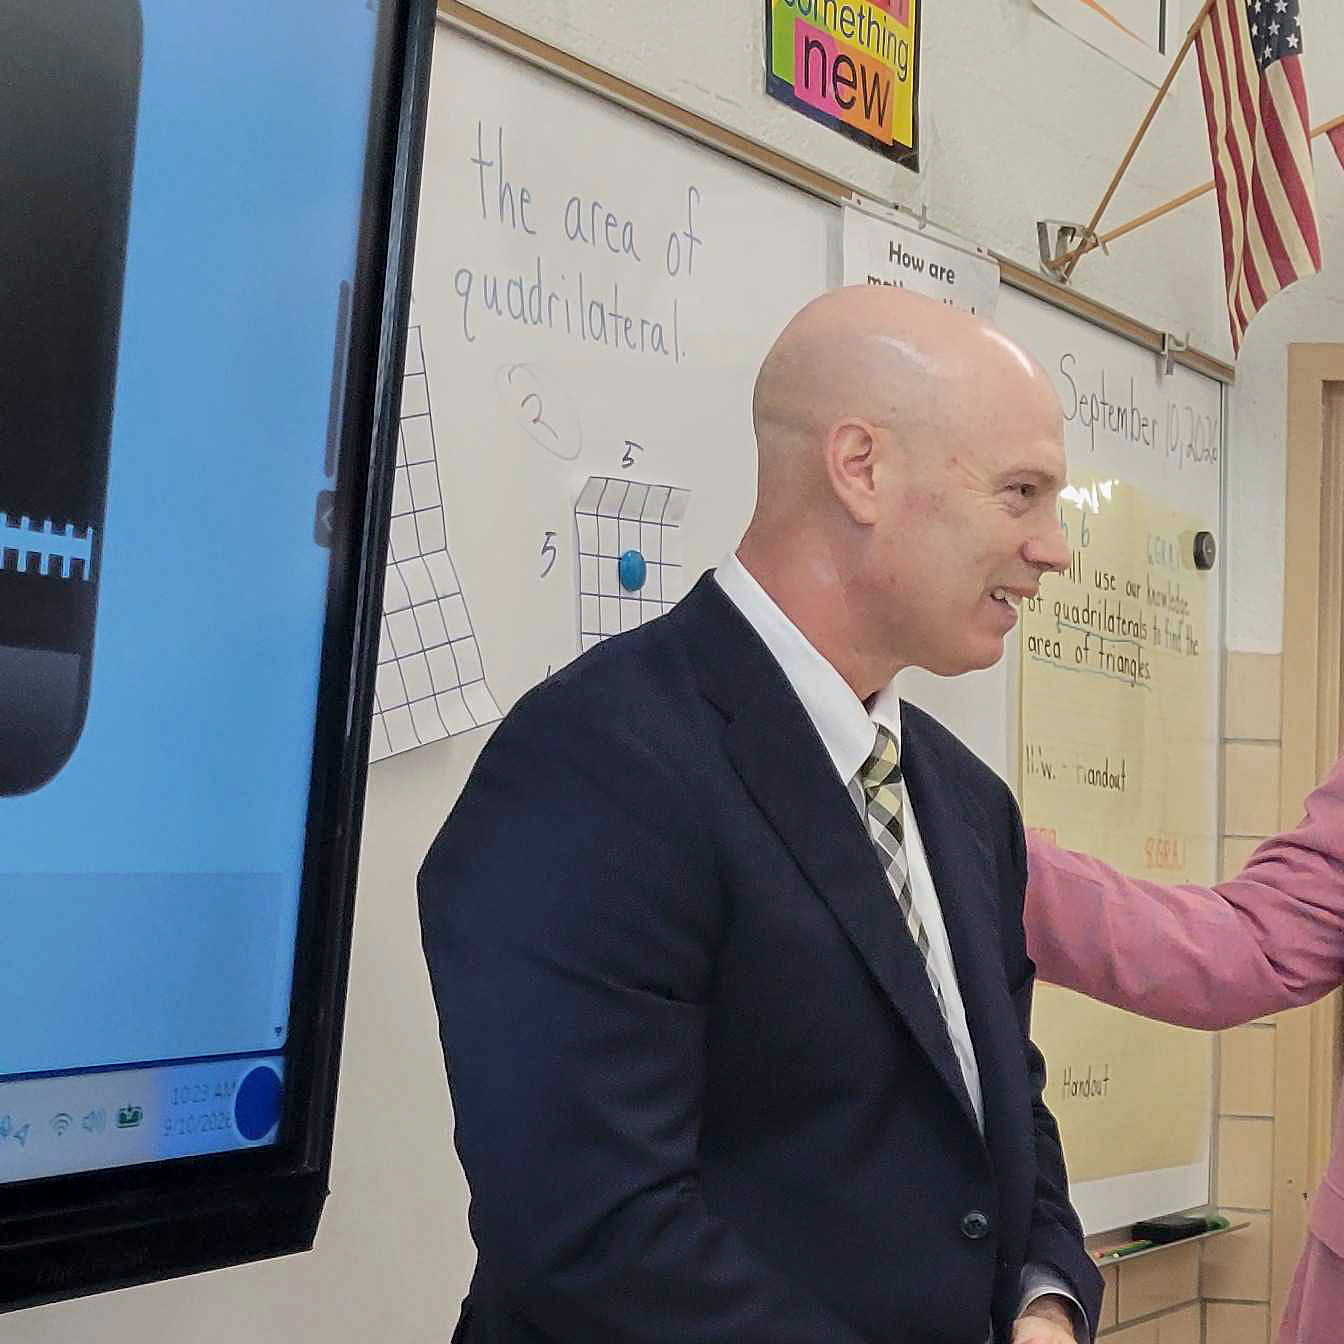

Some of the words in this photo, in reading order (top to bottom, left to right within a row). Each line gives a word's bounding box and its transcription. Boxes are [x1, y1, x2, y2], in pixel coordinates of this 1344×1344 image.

[782, 0, 908, 82] mething
[803, 33, 891, 128] new
[470, 120, 537, 235] the
[564, 196, 641, 262] area
[666, 185, 703, 276] of
[888, 240, 924, 274] How
[928, 261, 956, 285] are
[454, 256, 686, 363] quadrilateral.
[1059, 353, 1158, 452] September
[621, 439, 645, 469] 5
[539, 530, 559, 579] 5
[1094, 568, 1117, 591] use
[1125, 579, 1141, 599] our
[1053, 593, 1148, 641] quadrilaterals
[1028, 635, 1061, 660] area
[1075, 631, 1091, 665] of
[1098, 636, 1151, 688] triangles
[1062, 1062, 1111, 1100] Handout
